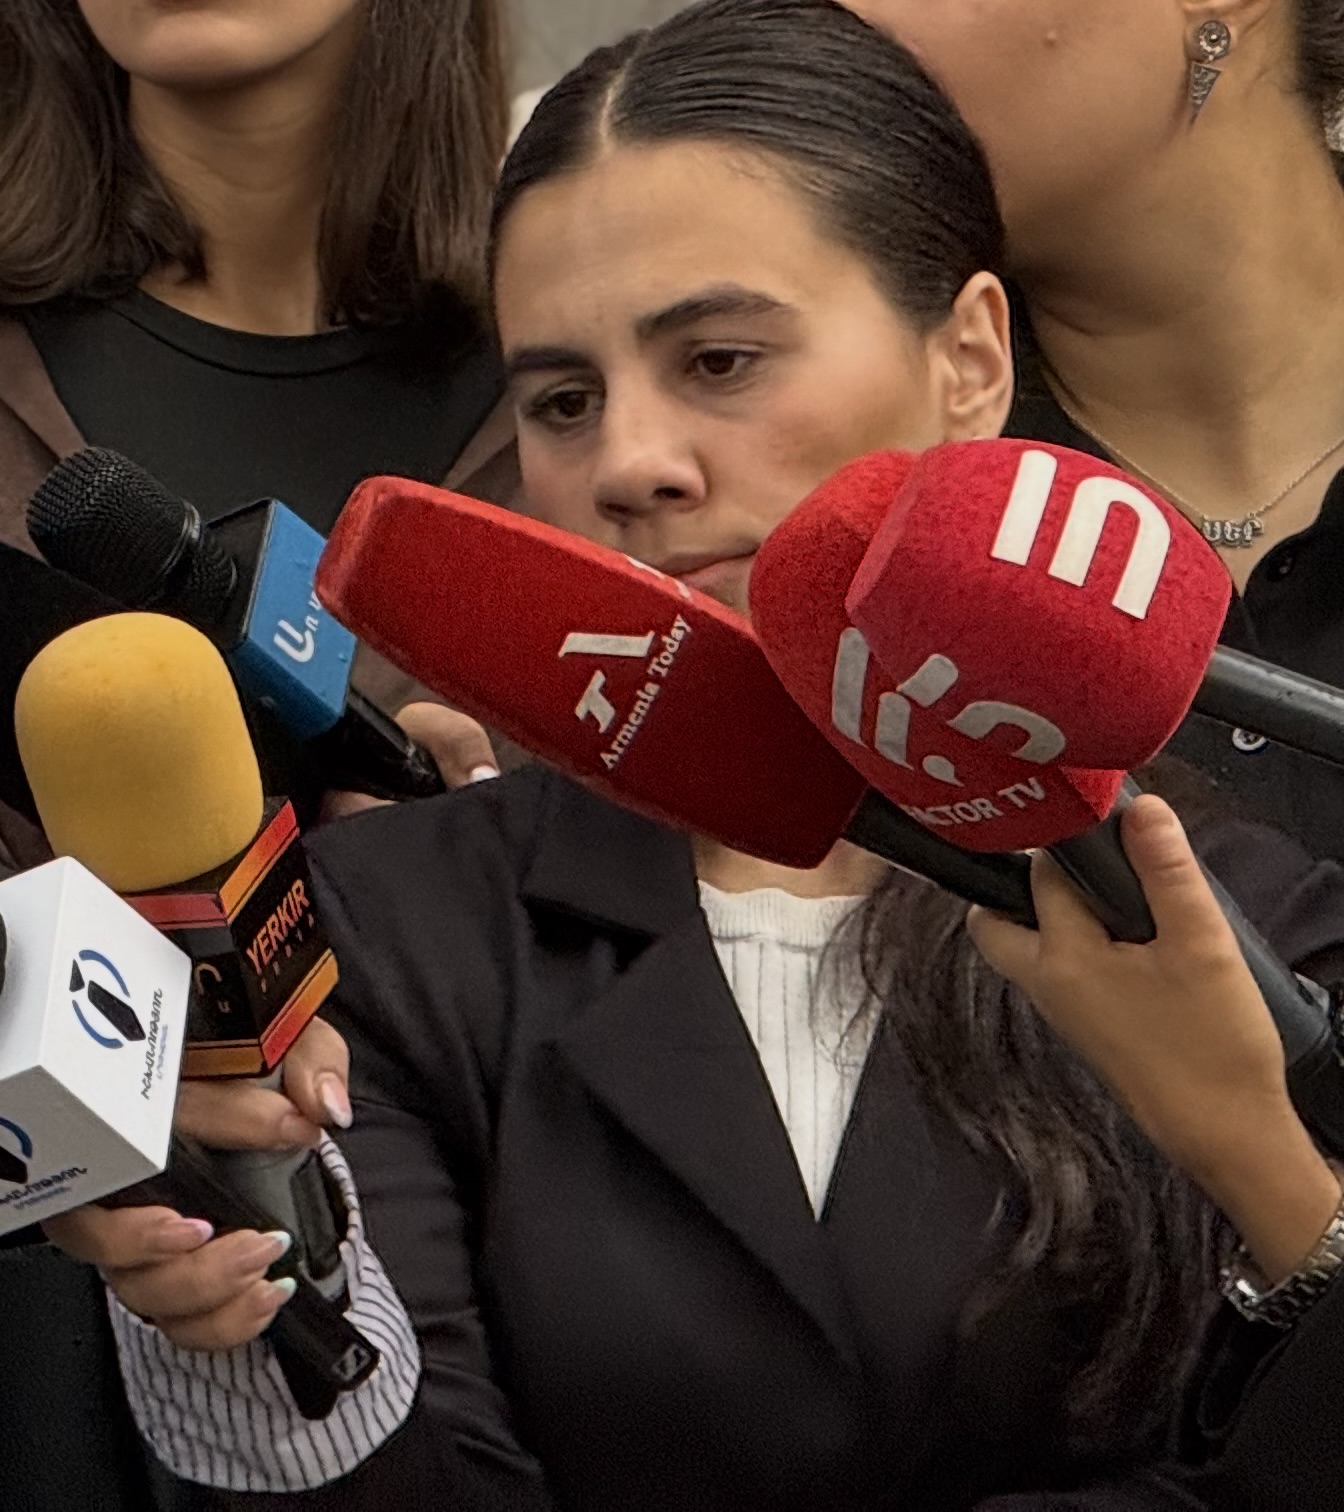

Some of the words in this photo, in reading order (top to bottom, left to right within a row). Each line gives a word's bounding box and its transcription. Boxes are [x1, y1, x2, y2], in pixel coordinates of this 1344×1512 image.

[600, 681, 661, 769] Armenia
[647, 613, 693, 678] Today
[997, 776, 1047, 810] TV
[245, 877, 310, 976] YERKIR
